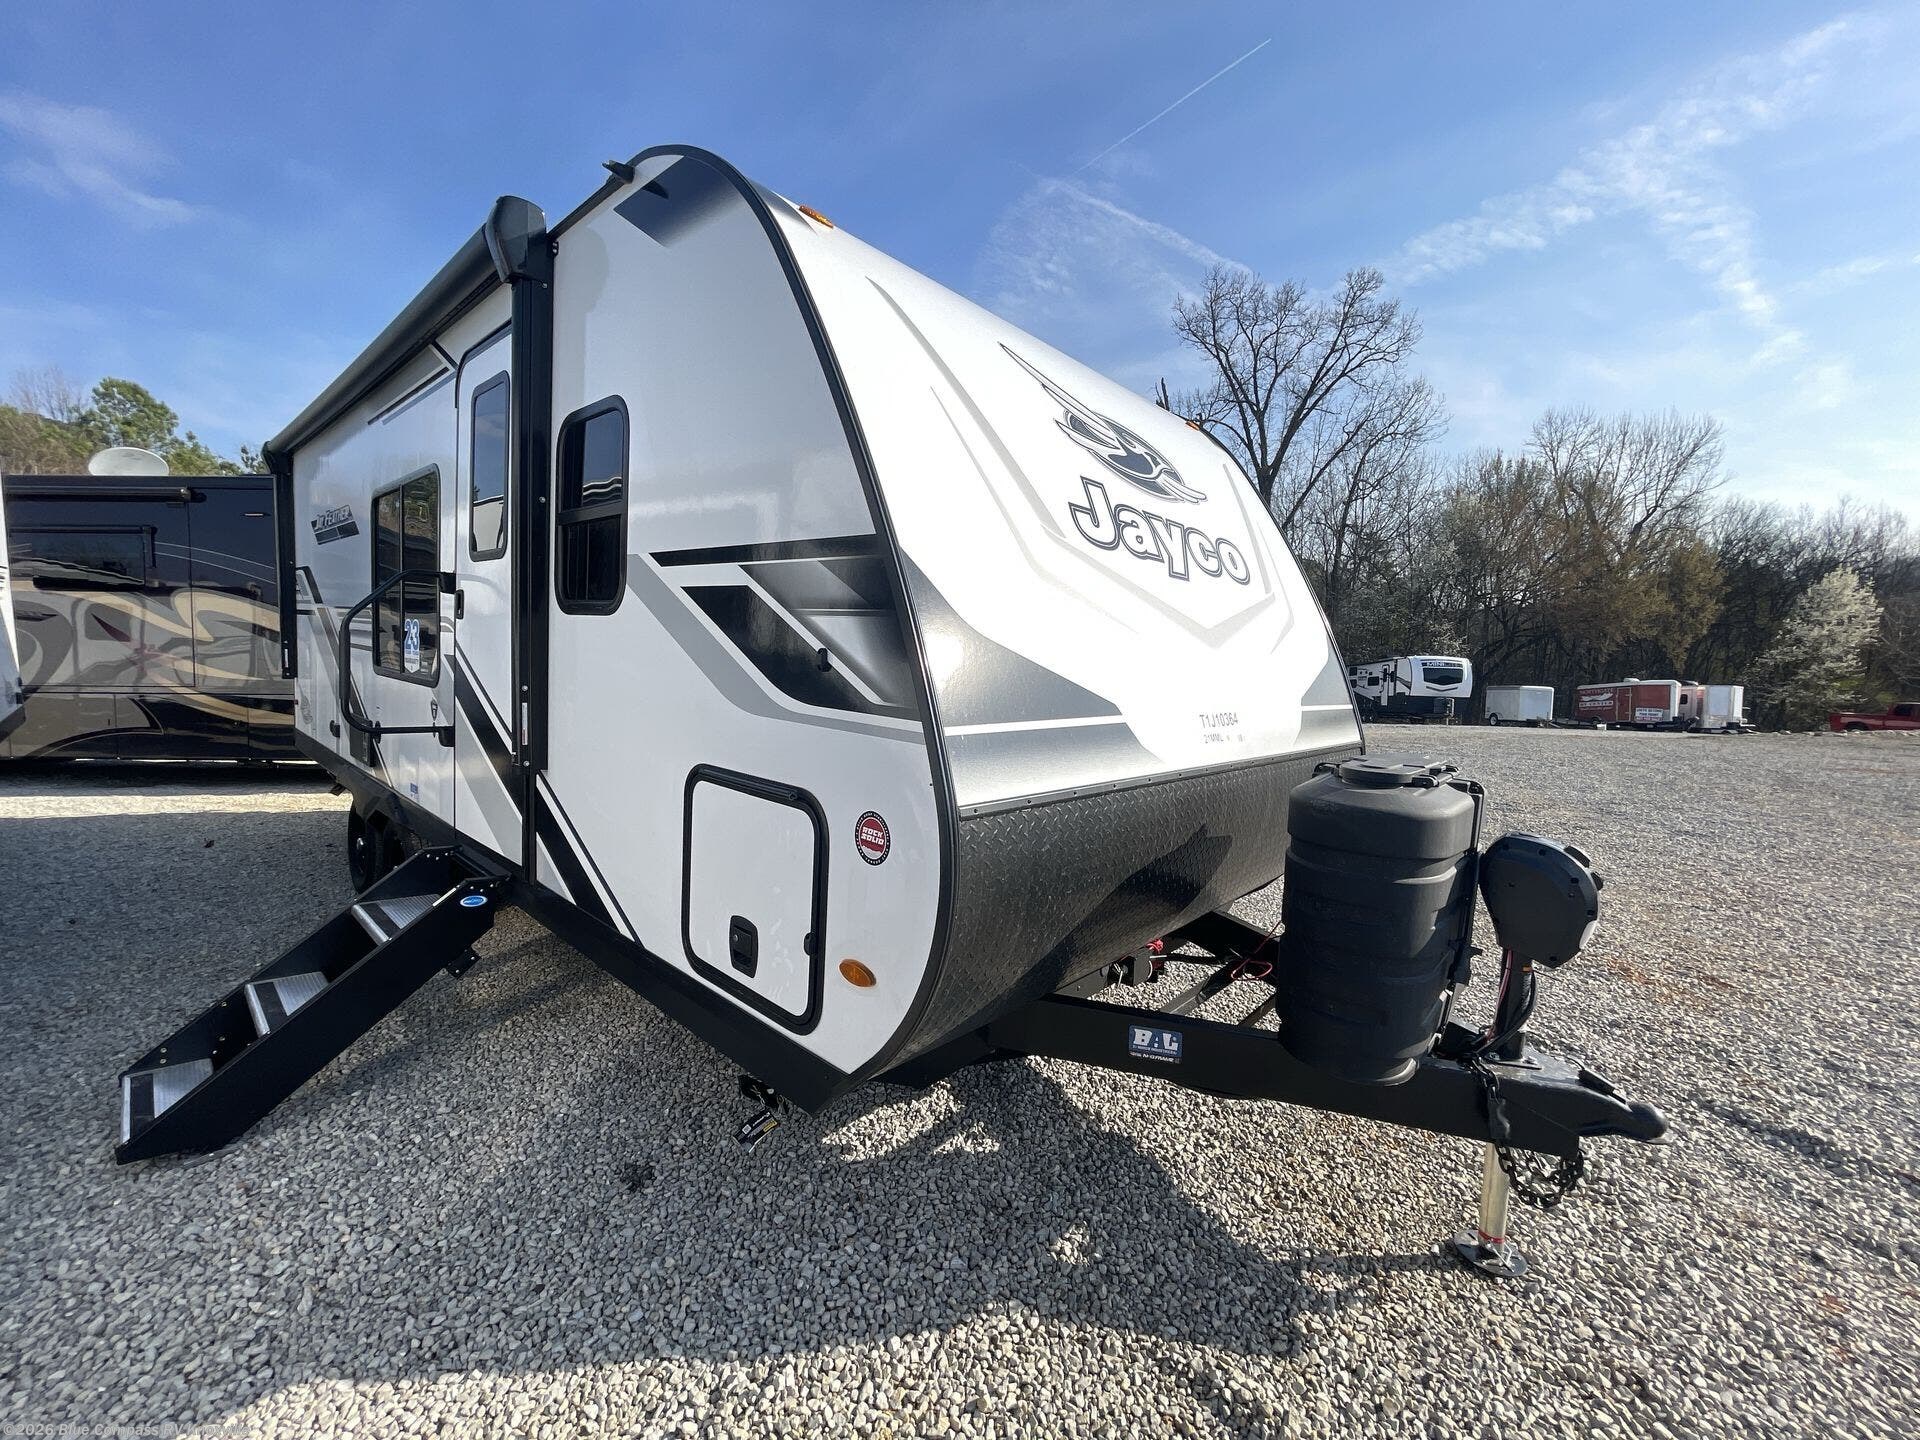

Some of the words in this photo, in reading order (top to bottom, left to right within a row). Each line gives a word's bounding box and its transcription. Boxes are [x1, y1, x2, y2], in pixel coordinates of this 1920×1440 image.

[1068, 475, 1250, 585] Jayco
[860, 832, 885, 845] SOLID
[862, 826, 884, 838] ROCK
